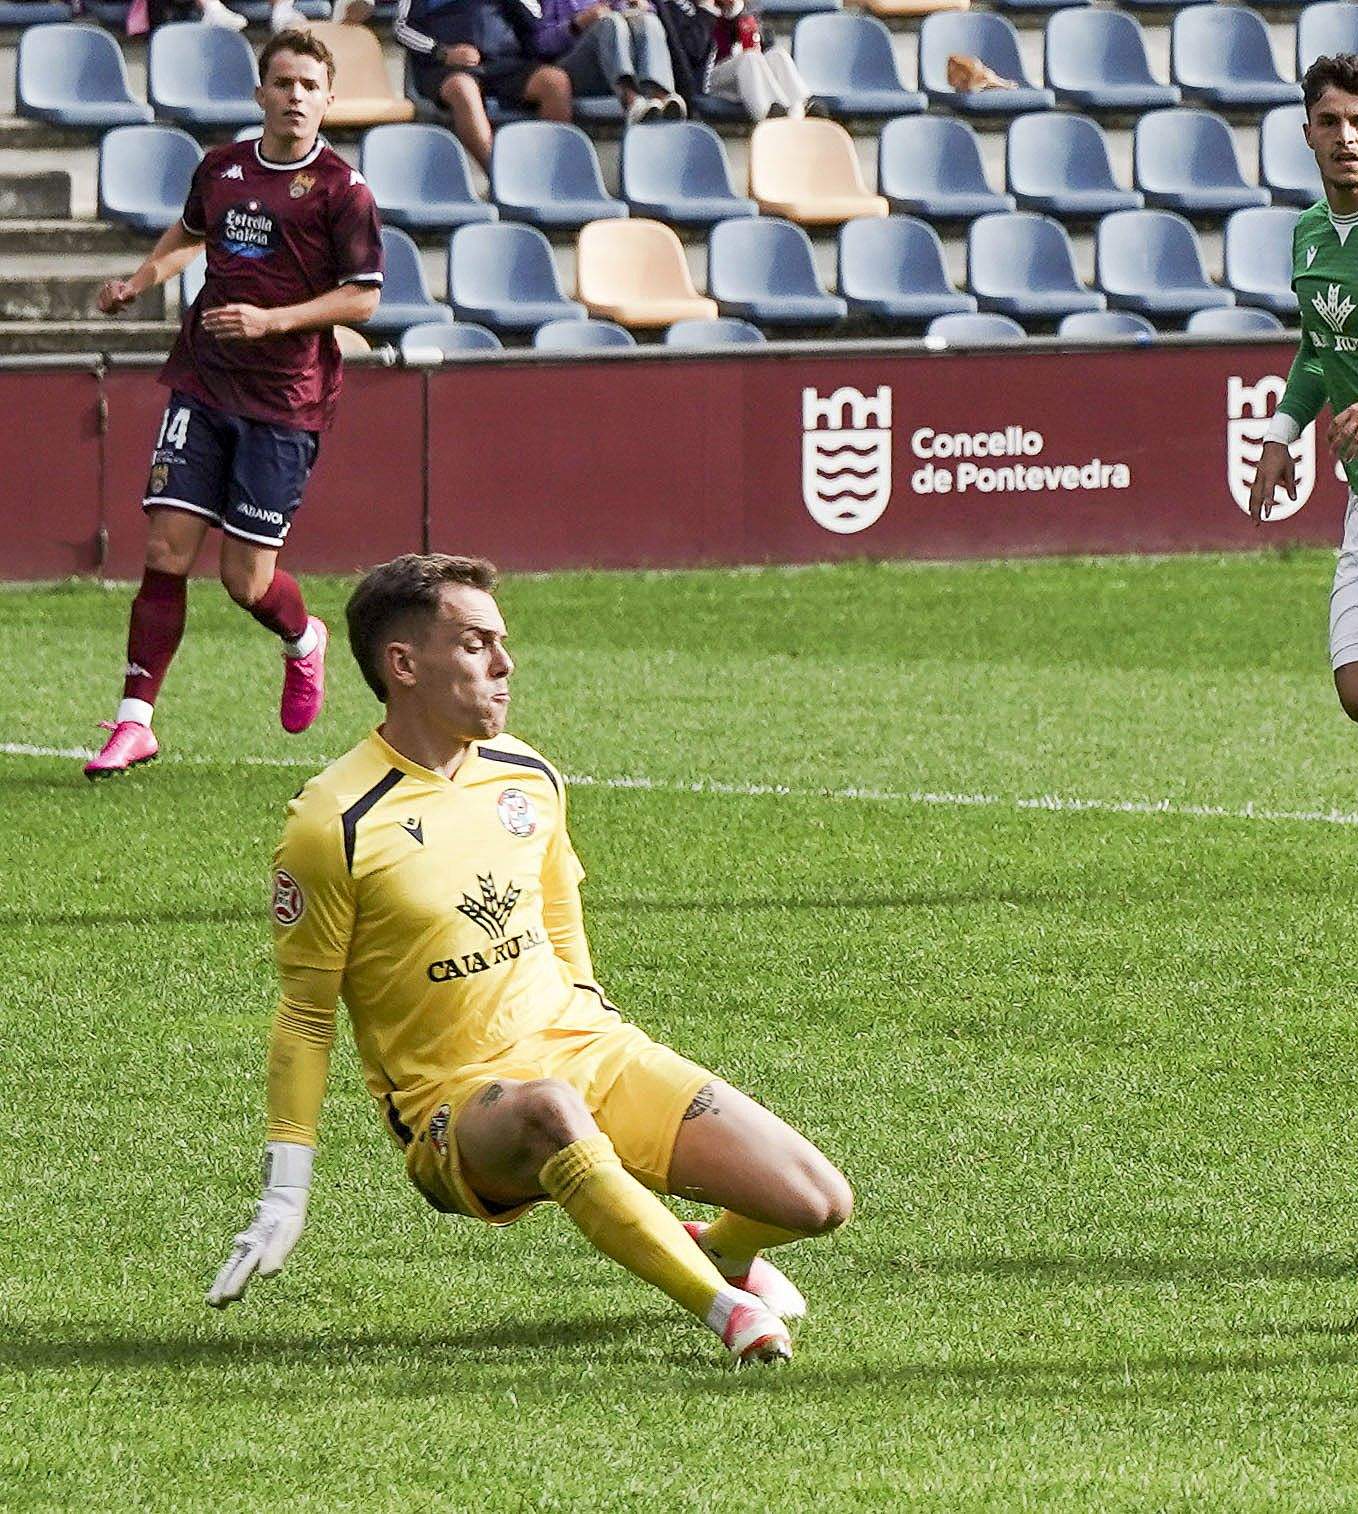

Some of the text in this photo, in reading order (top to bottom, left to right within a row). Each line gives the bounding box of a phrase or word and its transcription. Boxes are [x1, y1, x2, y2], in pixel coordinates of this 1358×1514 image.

[911, 425, 1044, 459] Concello
[911, 458, 1131, 494] de Pontevedra
